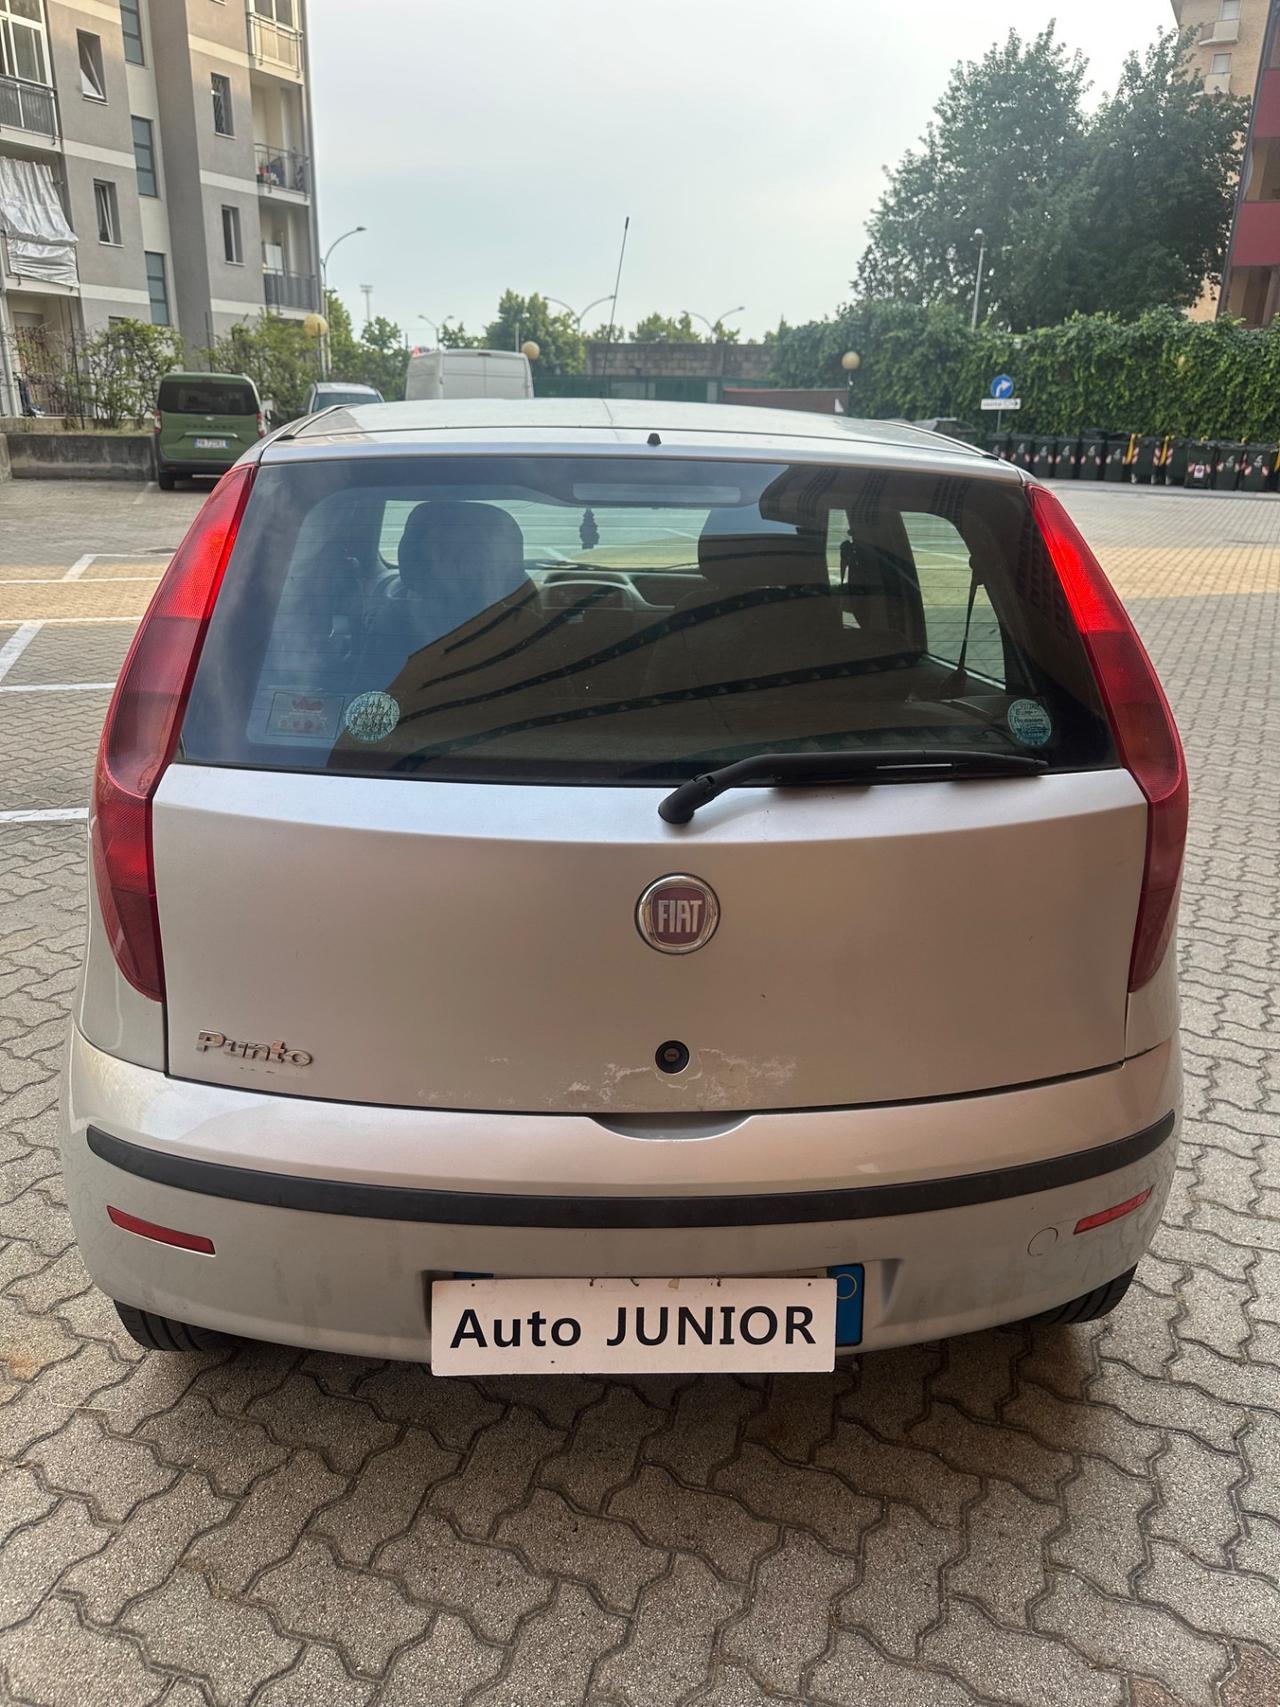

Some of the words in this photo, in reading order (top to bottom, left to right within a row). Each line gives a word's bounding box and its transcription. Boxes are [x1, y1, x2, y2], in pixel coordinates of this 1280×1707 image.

[658, 899, 703, 933] FIAT
[197, 1028, 314, 1067] Punto
[449, 1308, 582, 1348] Auto
[606, 1305, 817, 1347] JUNIOR
